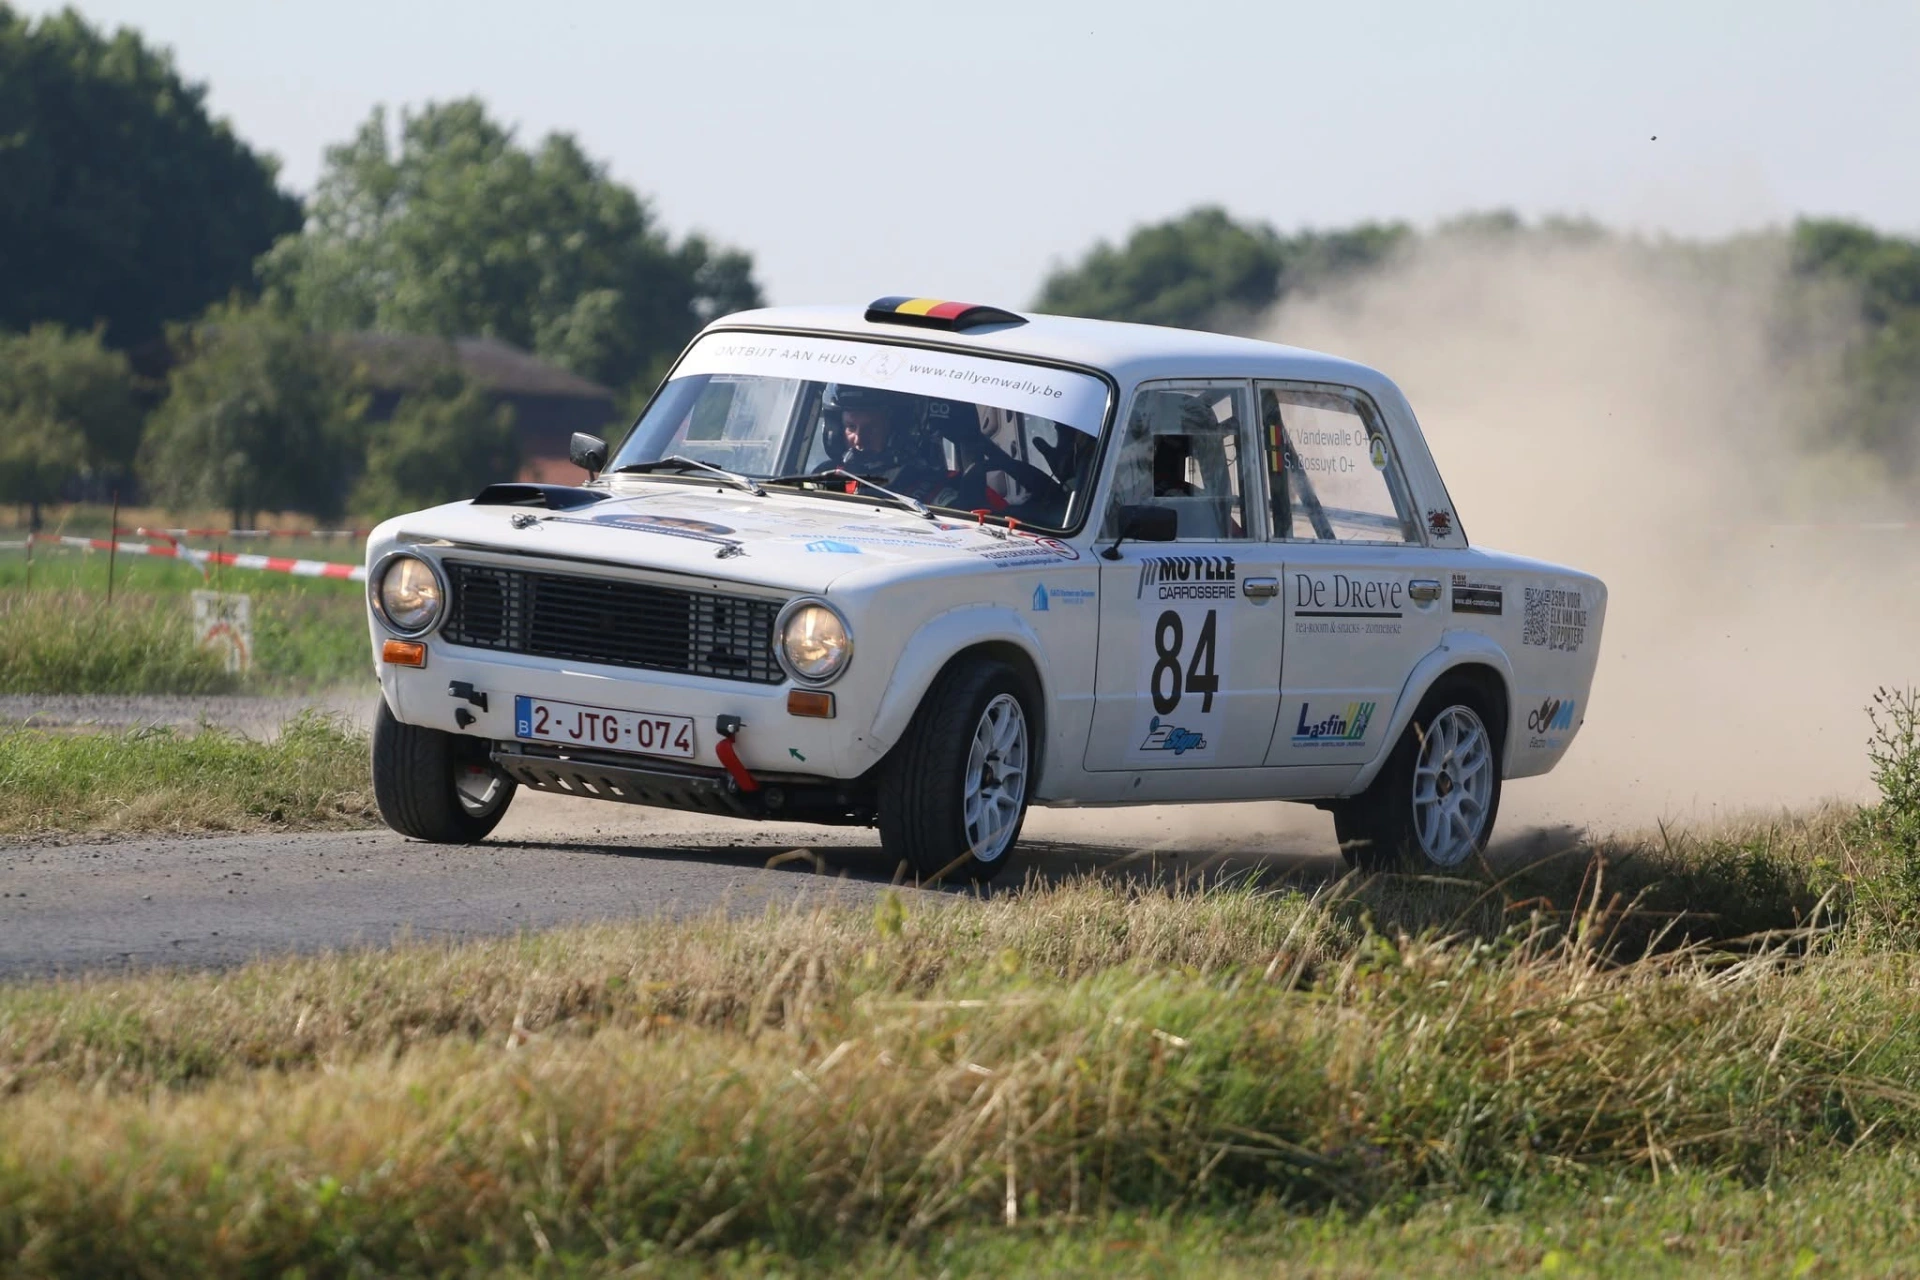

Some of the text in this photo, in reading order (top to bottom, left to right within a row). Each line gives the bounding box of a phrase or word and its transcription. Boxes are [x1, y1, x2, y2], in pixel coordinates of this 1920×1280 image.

[780, 350, 814, 361] AAN
[817, 354, 858, 366] HUIS
[909, 362, 1063, 400] www.tallyenwally.be
[1298, 429, 1351, 447] Vandewalle
[1355, 432, 1370, 447] O+
[1284, 453, 1356, 475] S. Bossuyt O+
[1156, 556, 1236, 581] MUYLLE
[1158, 585, 1236, 600] CARROSSERIE
[1295, 573, 1326, 608] De
[1151, 609, 1219, 716] 84
[518, 705, 691, 752] B 2-JTG-074
[1296, 702, 1347, 739] Lasfin
